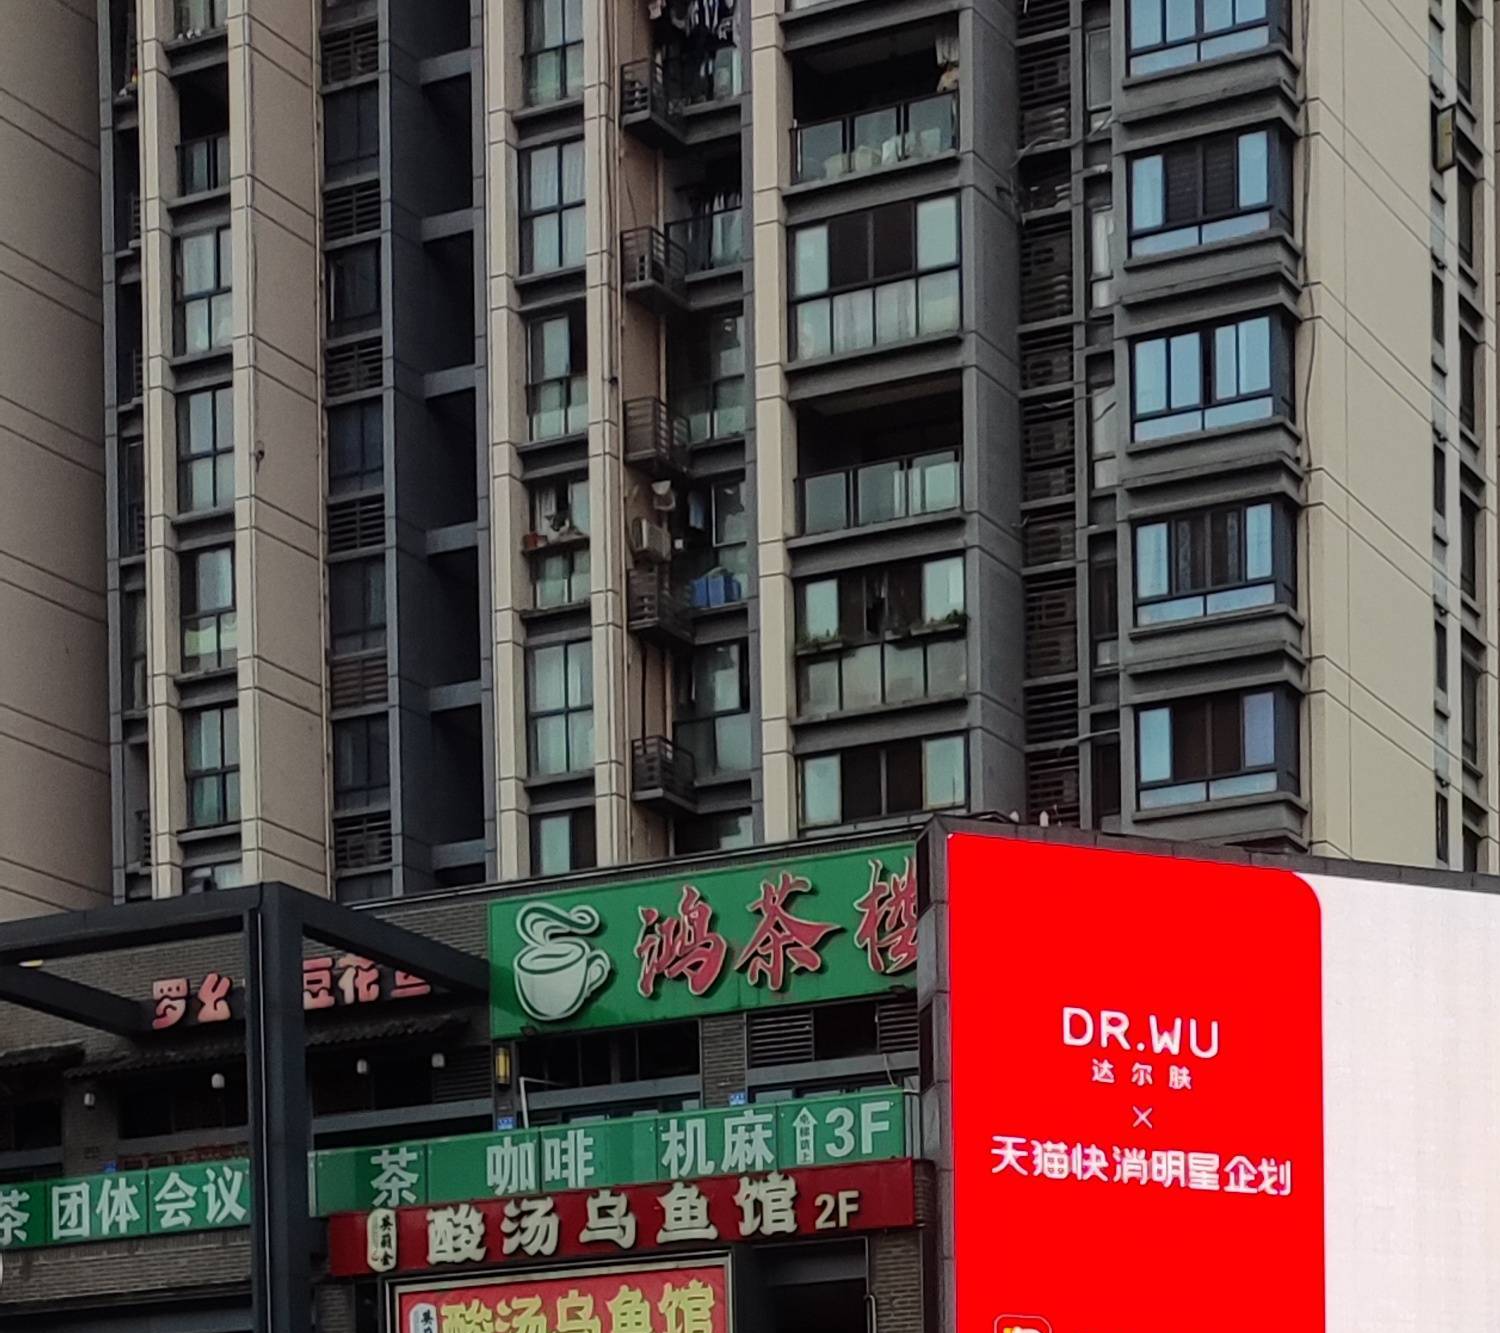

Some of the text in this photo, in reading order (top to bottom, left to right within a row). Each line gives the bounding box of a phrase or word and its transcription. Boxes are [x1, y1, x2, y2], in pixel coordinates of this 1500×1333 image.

[1062, 1006, 1219, 1059] DR.WU
[1092, 1058, 1192, 1090] 达尔肤
[370, 1101, 892, 1208] 茶 咖啡 机麻 3F
[990, 1135, 1292, 1196] 天猫快消明星企划
[426, 1171, 859, 1266] 酸汤乌鱼馆 2F
